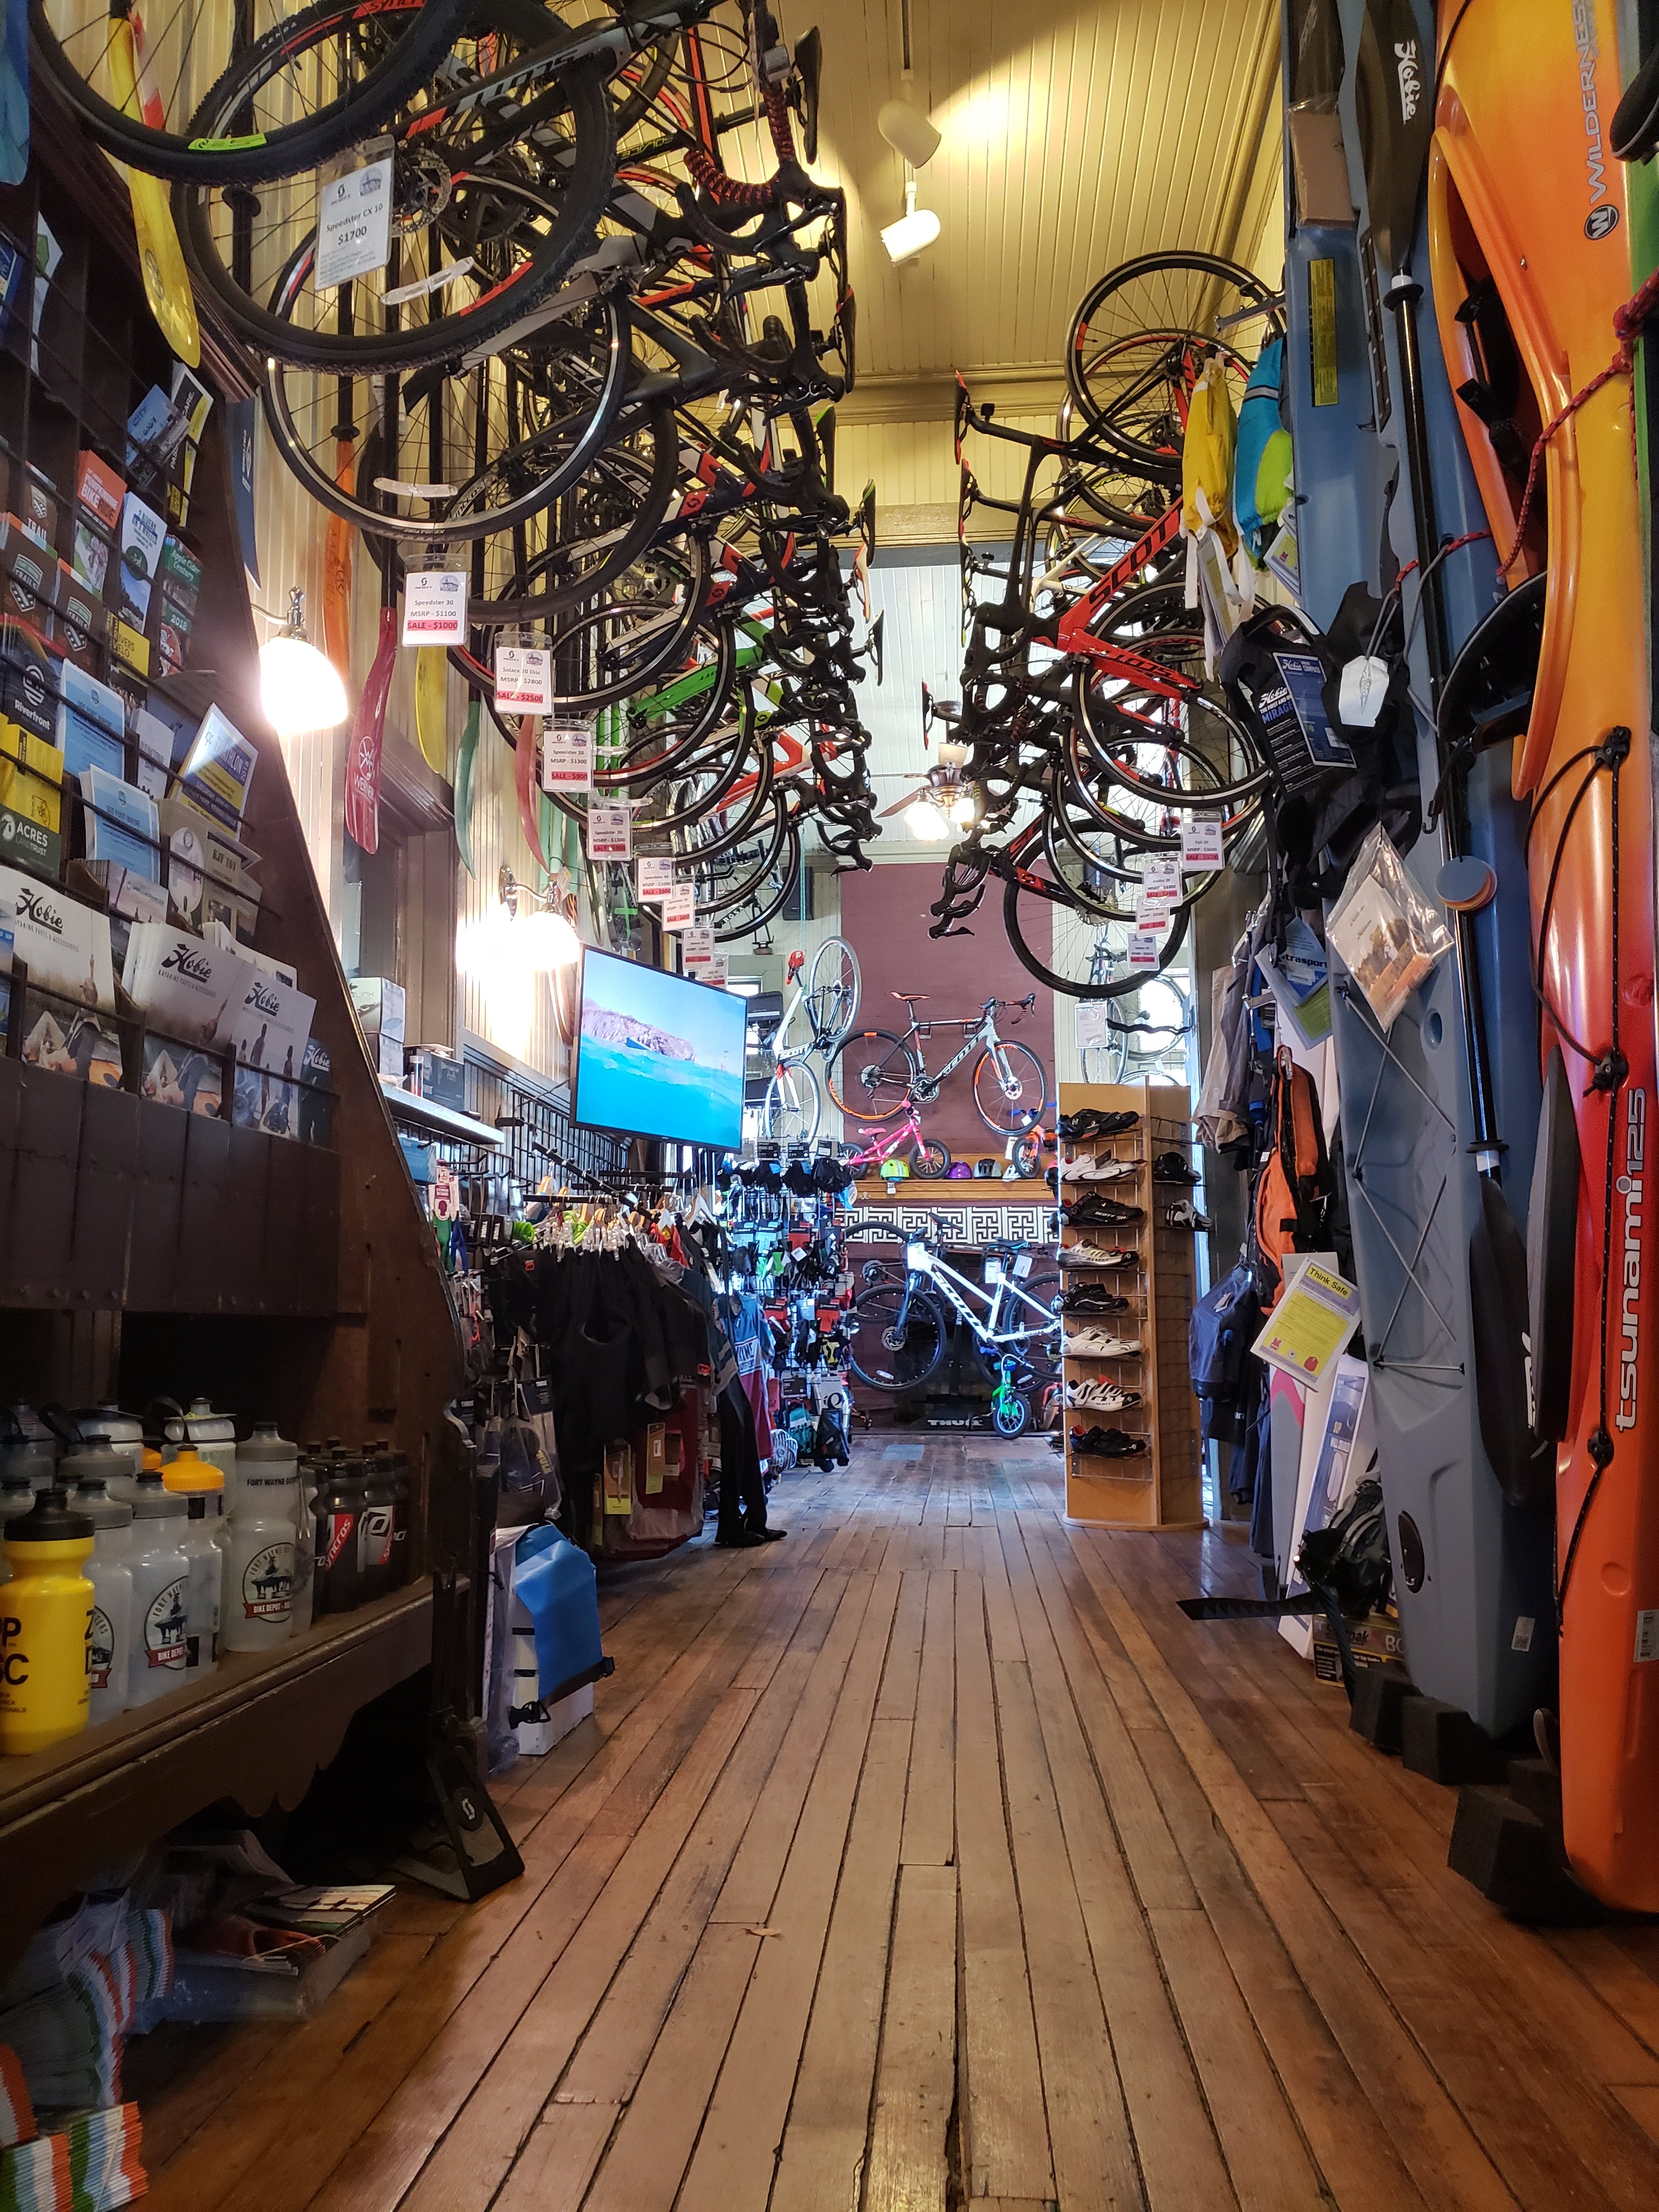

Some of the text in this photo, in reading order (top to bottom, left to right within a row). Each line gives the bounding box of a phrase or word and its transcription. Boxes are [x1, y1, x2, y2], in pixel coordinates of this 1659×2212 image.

[1394, 39, 1421, 125] Hobie
[1571, 0, 1606, 205] WILDERNES
[326, 202, 383, 233] Speedster CX 10
[337, 225, 367, 246] $1700
[81, 483, 101, 509] BIKE
[171, 549, 200, 574] Apple Cider
[173, 561, 194, 581] Century
[14, 568, 37, 590] TRAILS
[171, 613, 188, 631] 2018
[112, 639, 131, 657] VELO
[113, 631, 135, 652] RIVERS
[1283, 658, 1302, 671] Hobie
[521, 693, 543, 702] $2500
[1258, 686, 1288, 709] Hobie
[1267, 701, 1278, 712] FIRST
[14, 699, 50, 731] Riverfront
[17, 821, 48, 847] ACRES
[15, 887, 63, 934] Hobie
[161, 943, 212, 984] Hobie
[244, 982, 280, 1017] Hobie
[303, 1045, 330, 1072] Hobie
[780, 1043, 810, 1060] SCOTT
[943, 1035, 980, 1076] SCOTT
[1616, 1087, 1645, 1432] tsunami 125
[1310, 1267, 1330, 1285] Think
[1331, 1281, 1348, 1296] Safe
[933, 1271, 982, 1327] SCOTT
[152, 1598, 167, 1618] FORT
[253, 1603, 280, 1614] BIKE DEPOT
[157, 1651, 171, 1662] BIKE
